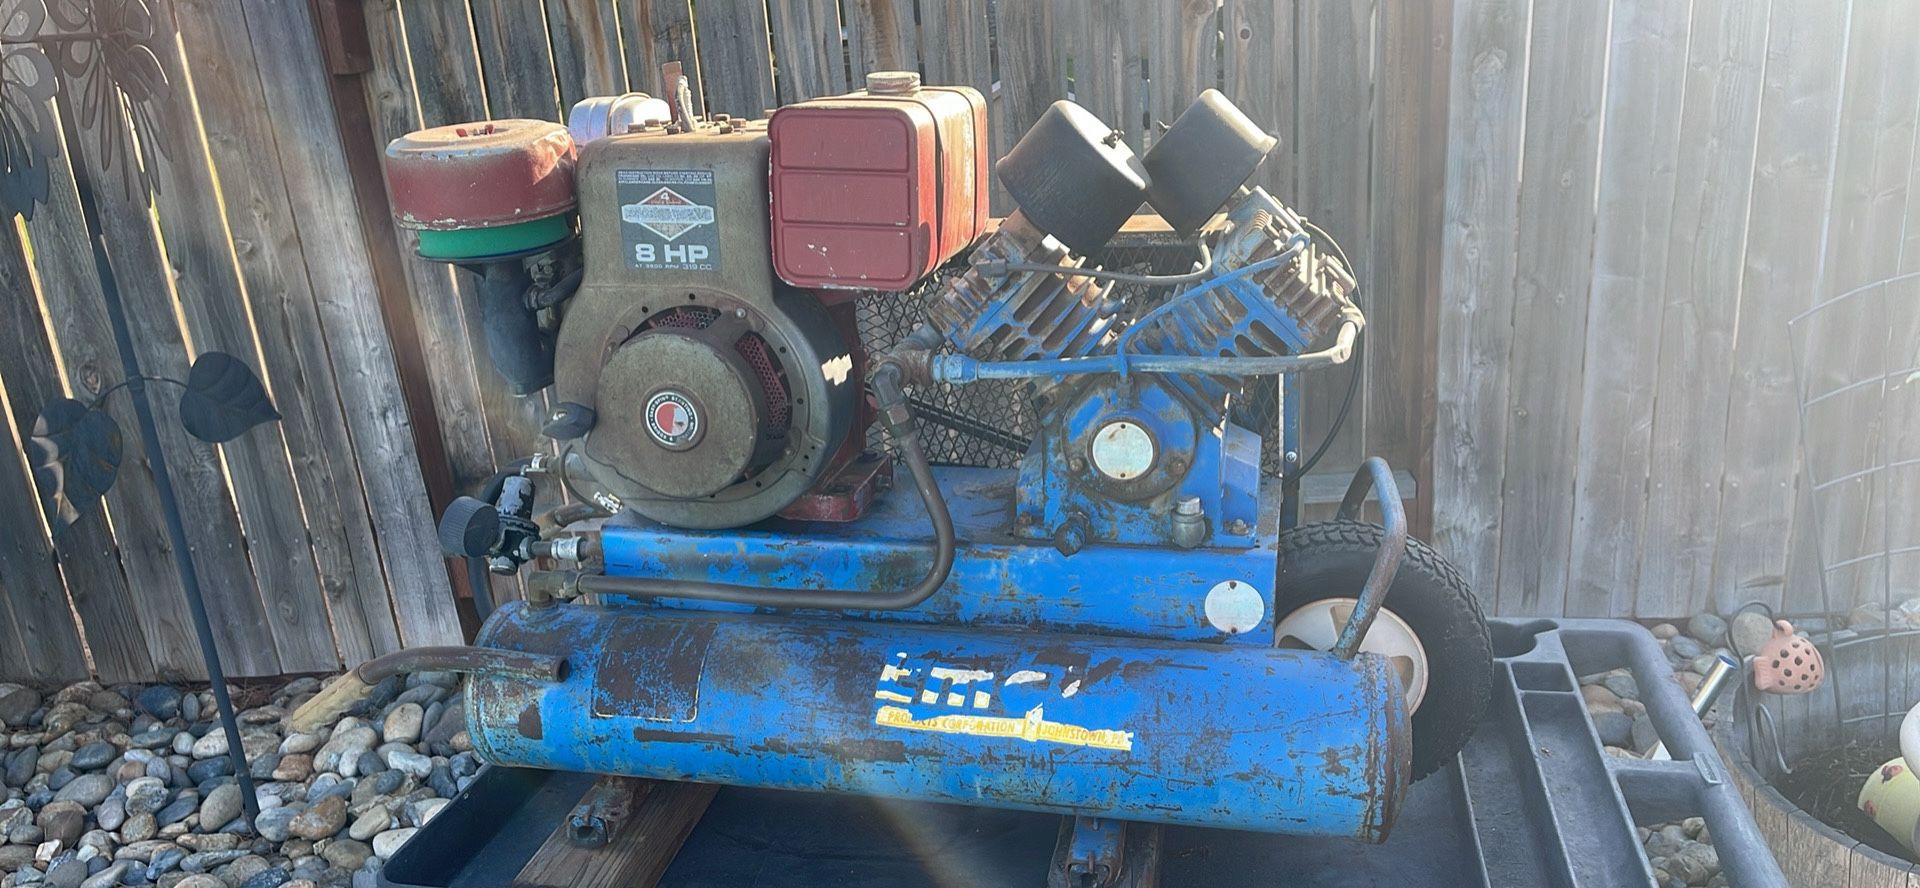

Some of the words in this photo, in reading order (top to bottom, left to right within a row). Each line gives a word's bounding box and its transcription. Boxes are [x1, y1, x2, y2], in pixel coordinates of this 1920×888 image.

[660, 192, 670, 200] 4
[635, 243, 656, 262] 8
[664, 244, 709, 263] HP
